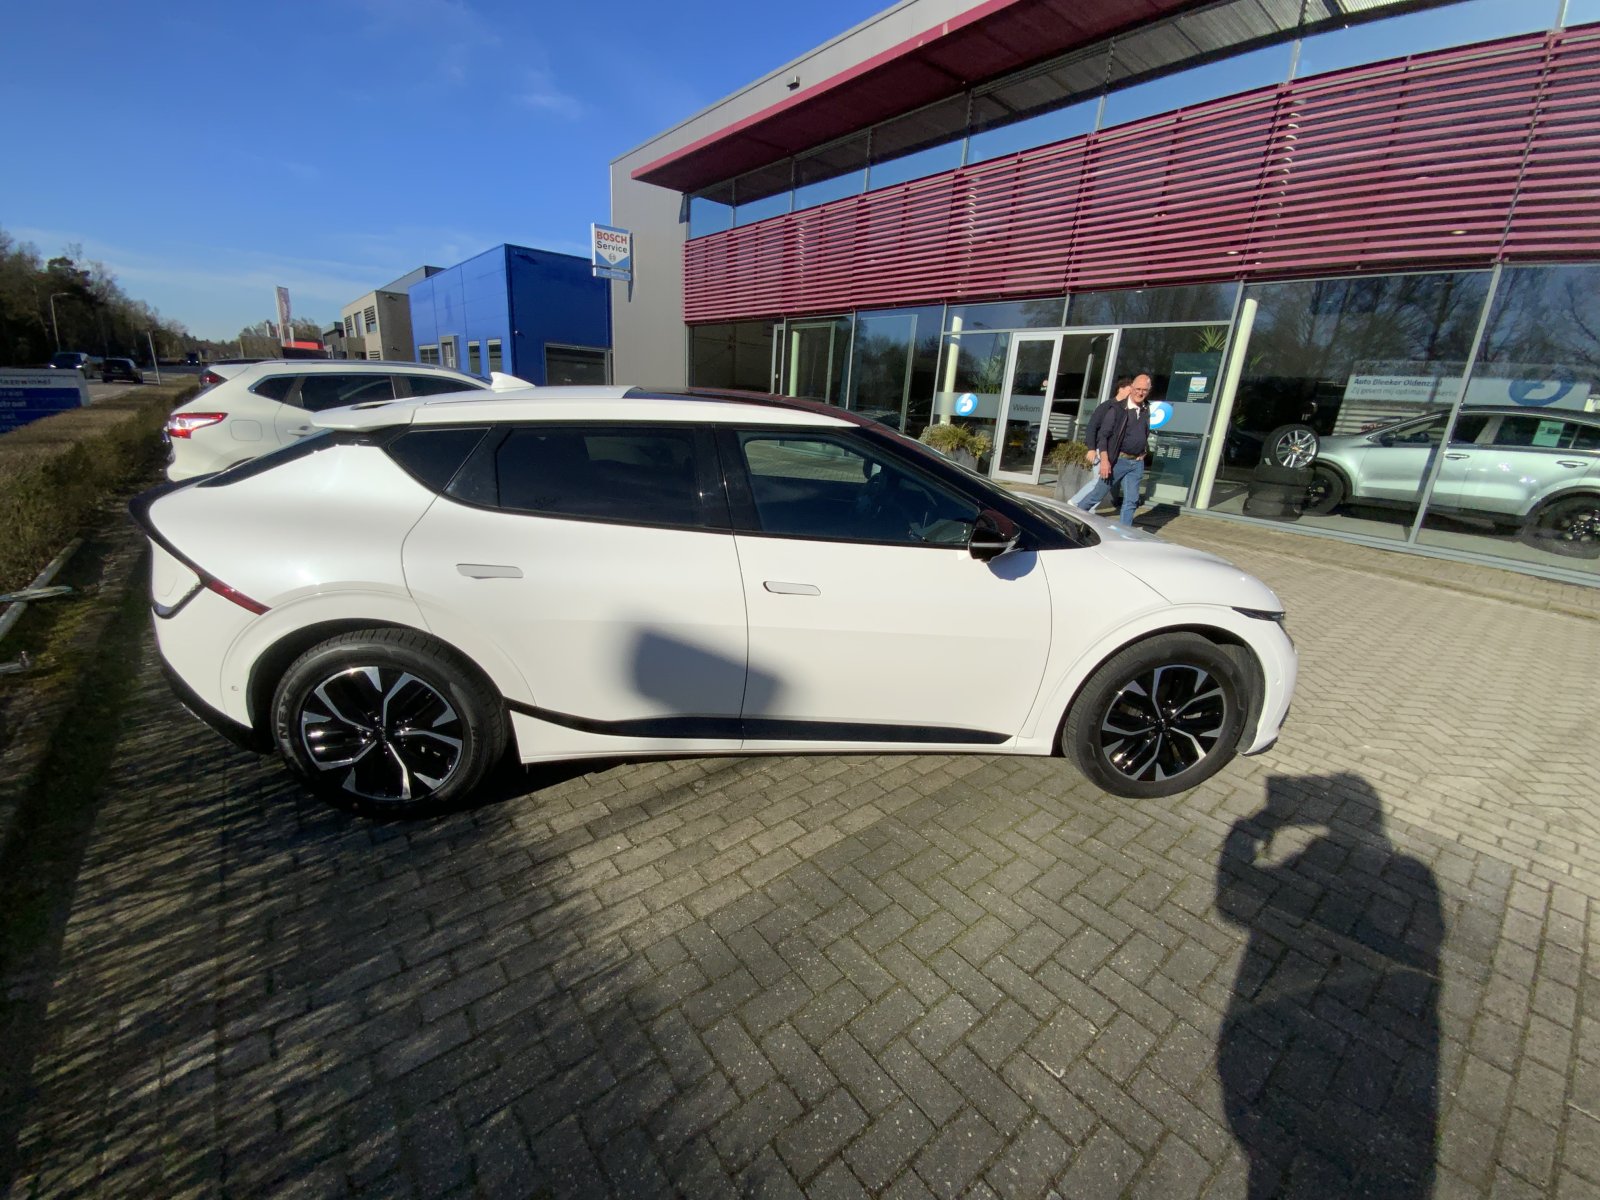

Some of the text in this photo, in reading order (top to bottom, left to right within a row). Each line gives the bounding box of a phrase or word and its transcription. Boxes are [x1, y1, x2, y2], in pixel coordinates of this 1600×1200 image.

[596, 231, 627, 244] BOSCH
[596, 240, 628, 253] Service
[1403, 379, 1443, 387] Oldenzal
[1012, 403, 1041, 413] Welkom
